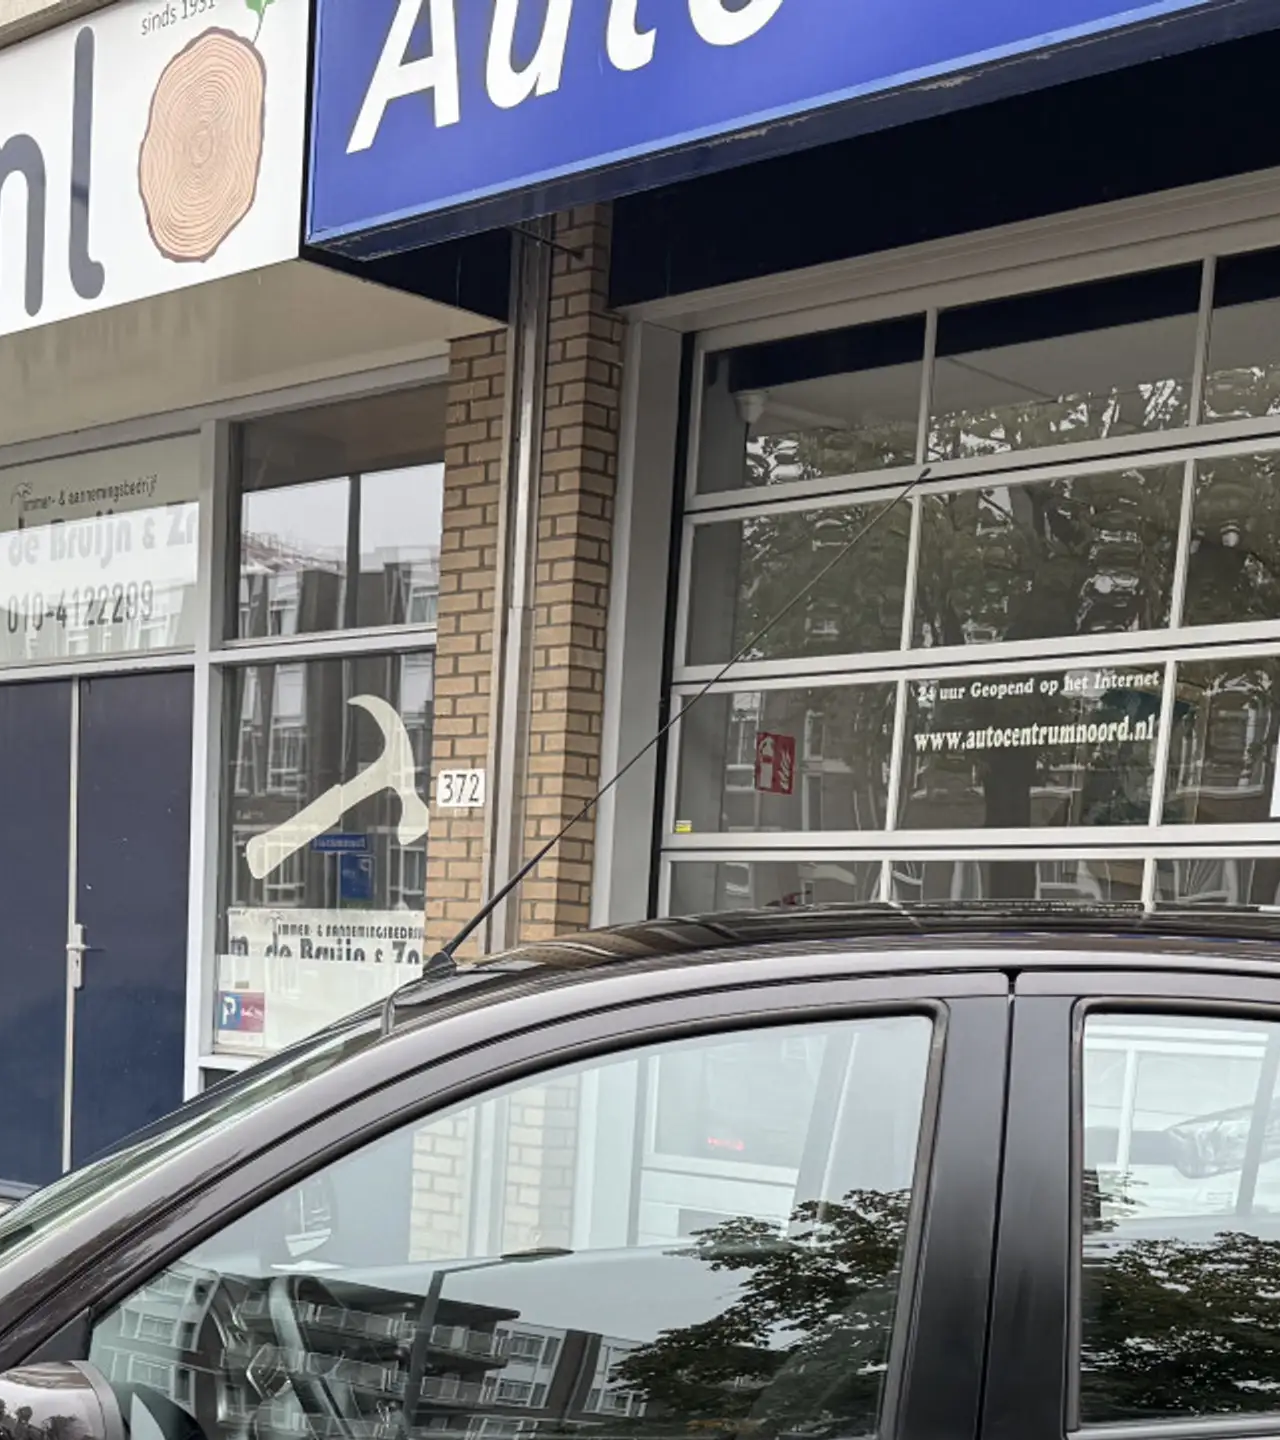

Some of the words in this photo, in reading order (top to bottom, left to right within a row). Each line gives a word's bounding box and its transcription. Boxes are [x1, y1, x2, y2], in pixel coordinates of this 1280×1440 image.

[141, 3, 177, 35] sinds
[8, 517, 40, 566] de
[50, 508, 132, 569] Bruijn
[917, 685, 936, 703] 24
[940, 684, 966, 702] uur
[970, 677, 1036, 701] Geopend
[1040, 677, 1061, 697] op
[1063, 673, 1090, 694] het
[1093, 668, 1160, 692] Internet
[913, 712, 1156, 752] www.autocentrumnoord.nl
[440, 773, 481, 804] 372
